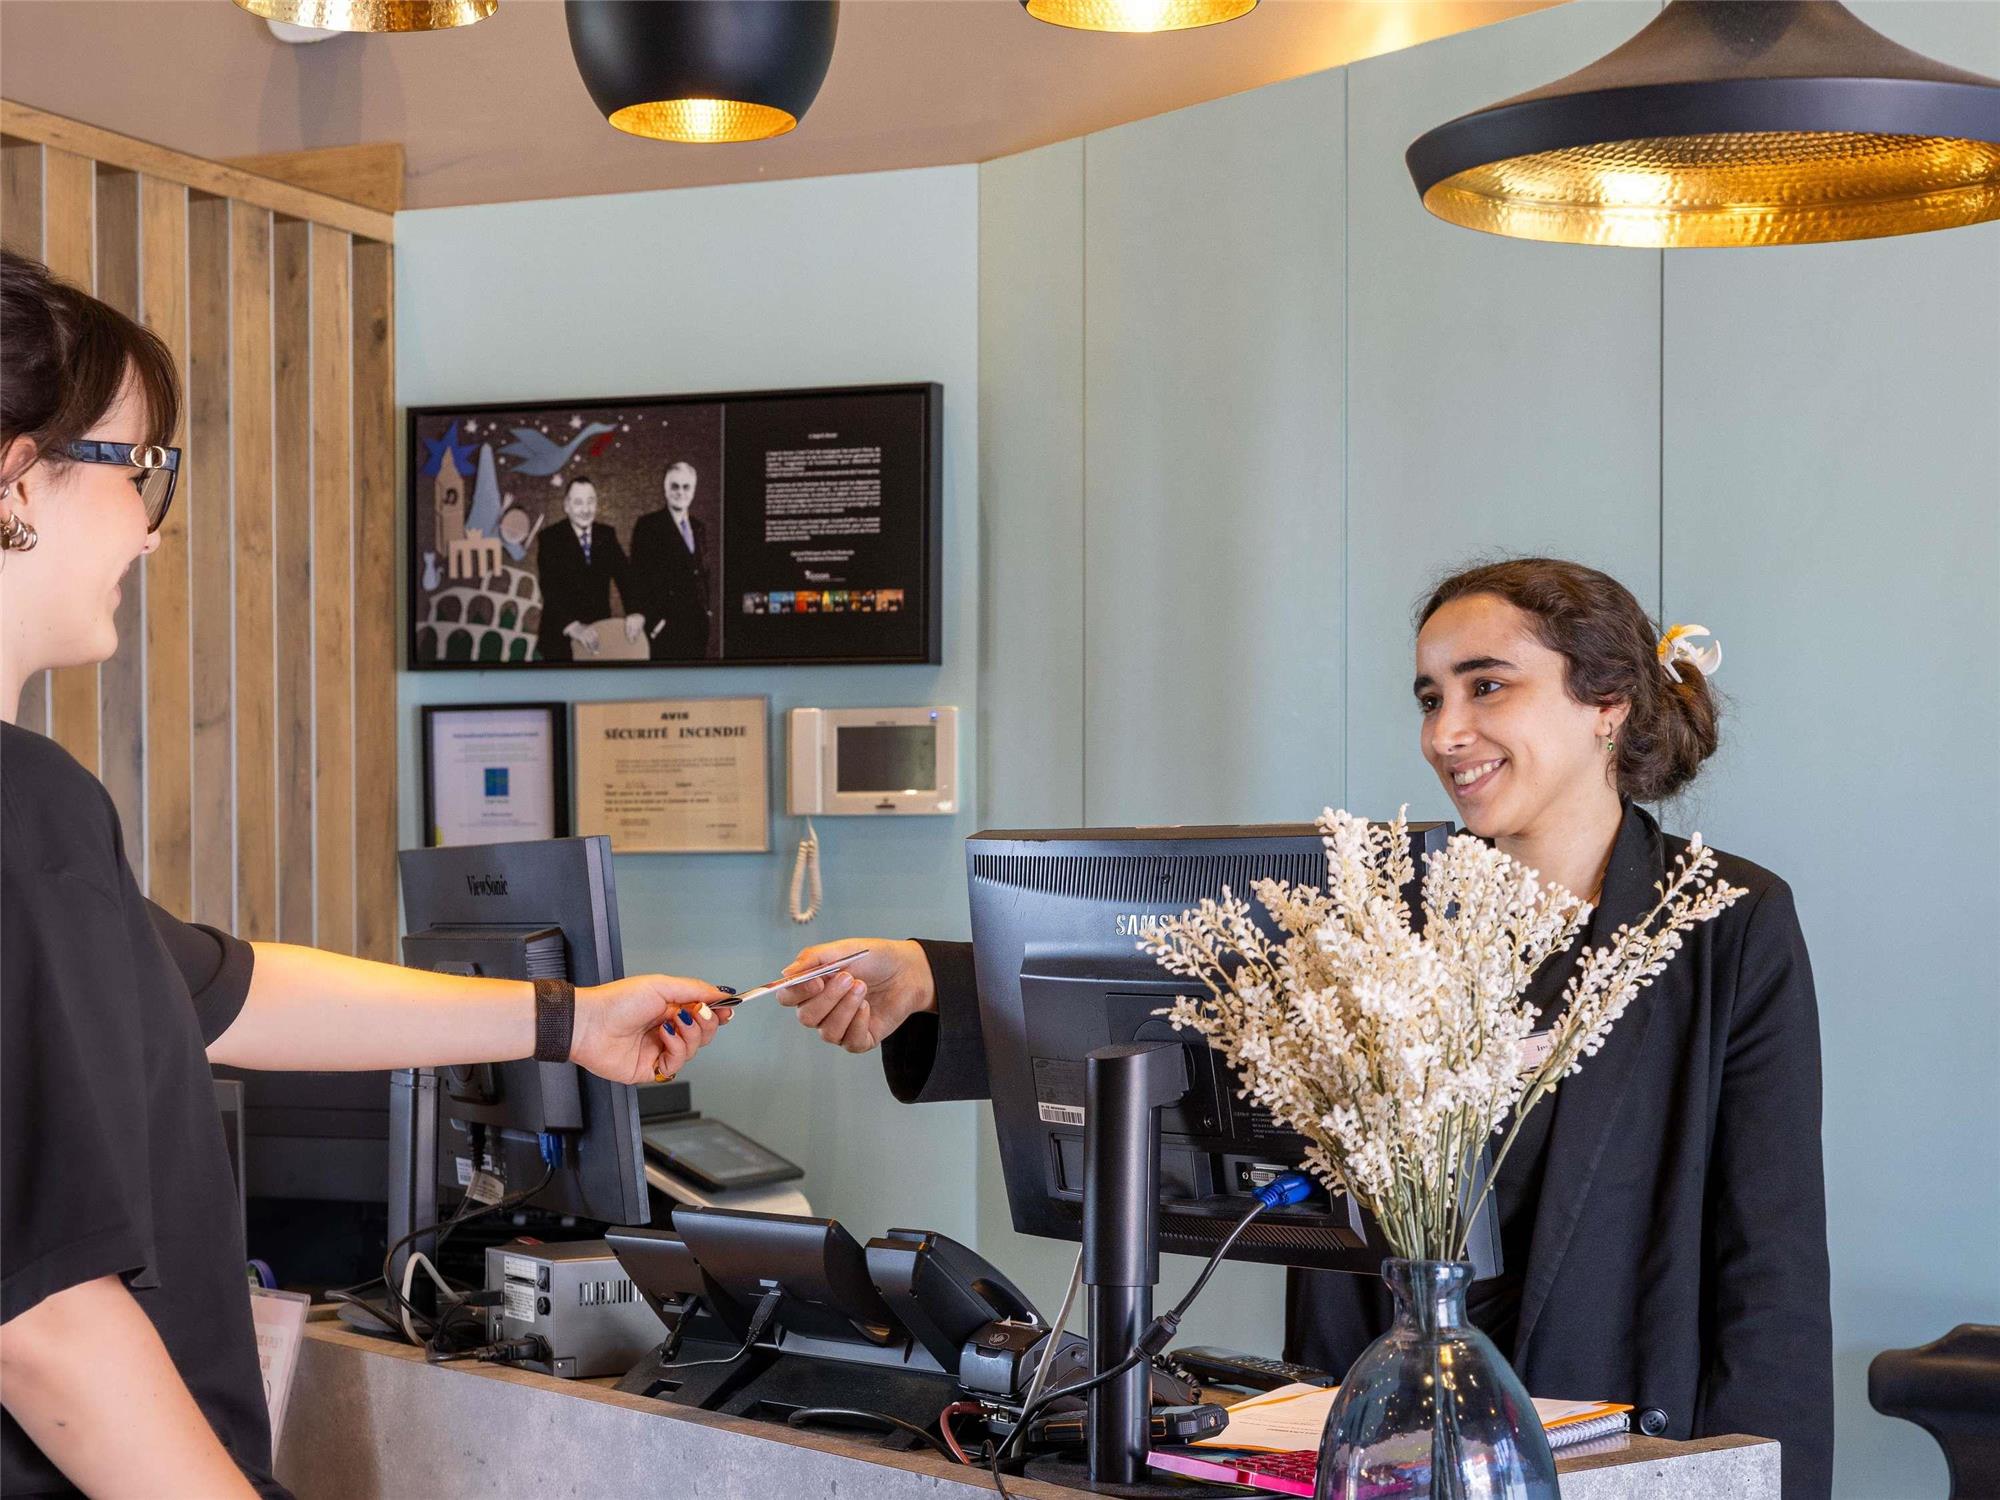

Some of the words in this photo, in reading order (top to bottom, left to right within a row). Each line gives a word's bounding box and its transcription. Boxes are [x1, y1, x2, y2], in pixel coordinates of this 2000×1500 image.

[679, 726, 747, 739] INCENDIE
[466, 874, 509, 896] ViewSonic
[1115, 914, 1183, 936] SAMS
